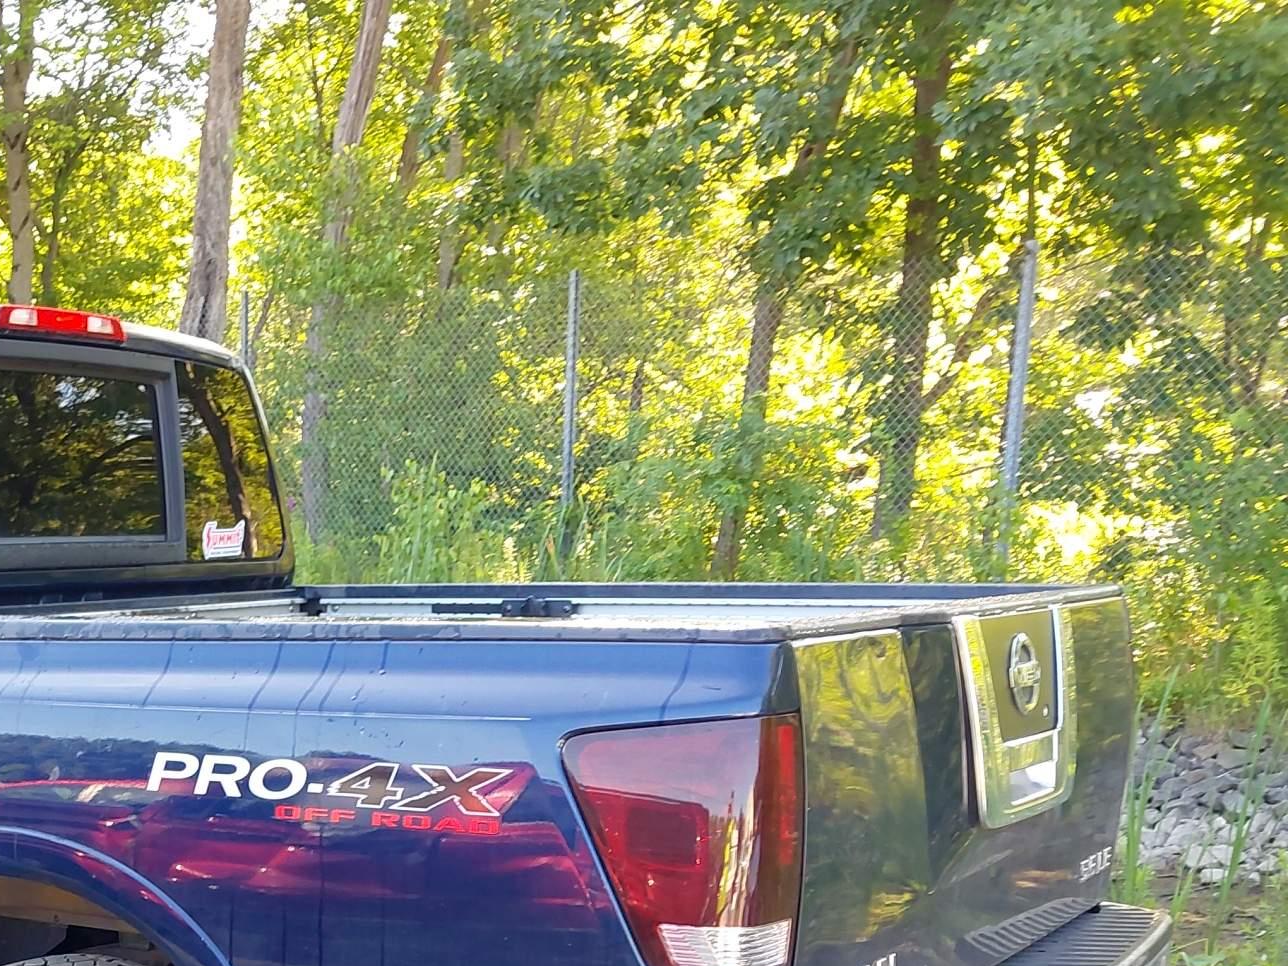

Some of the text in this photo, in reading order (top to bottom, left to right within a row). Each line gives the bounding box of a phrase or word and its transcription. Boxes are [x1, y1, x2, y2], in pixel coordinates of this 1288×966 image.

[146, 751, 513, 817] PRO-4X
[274, 804, 501, 835] OFF ROAD
